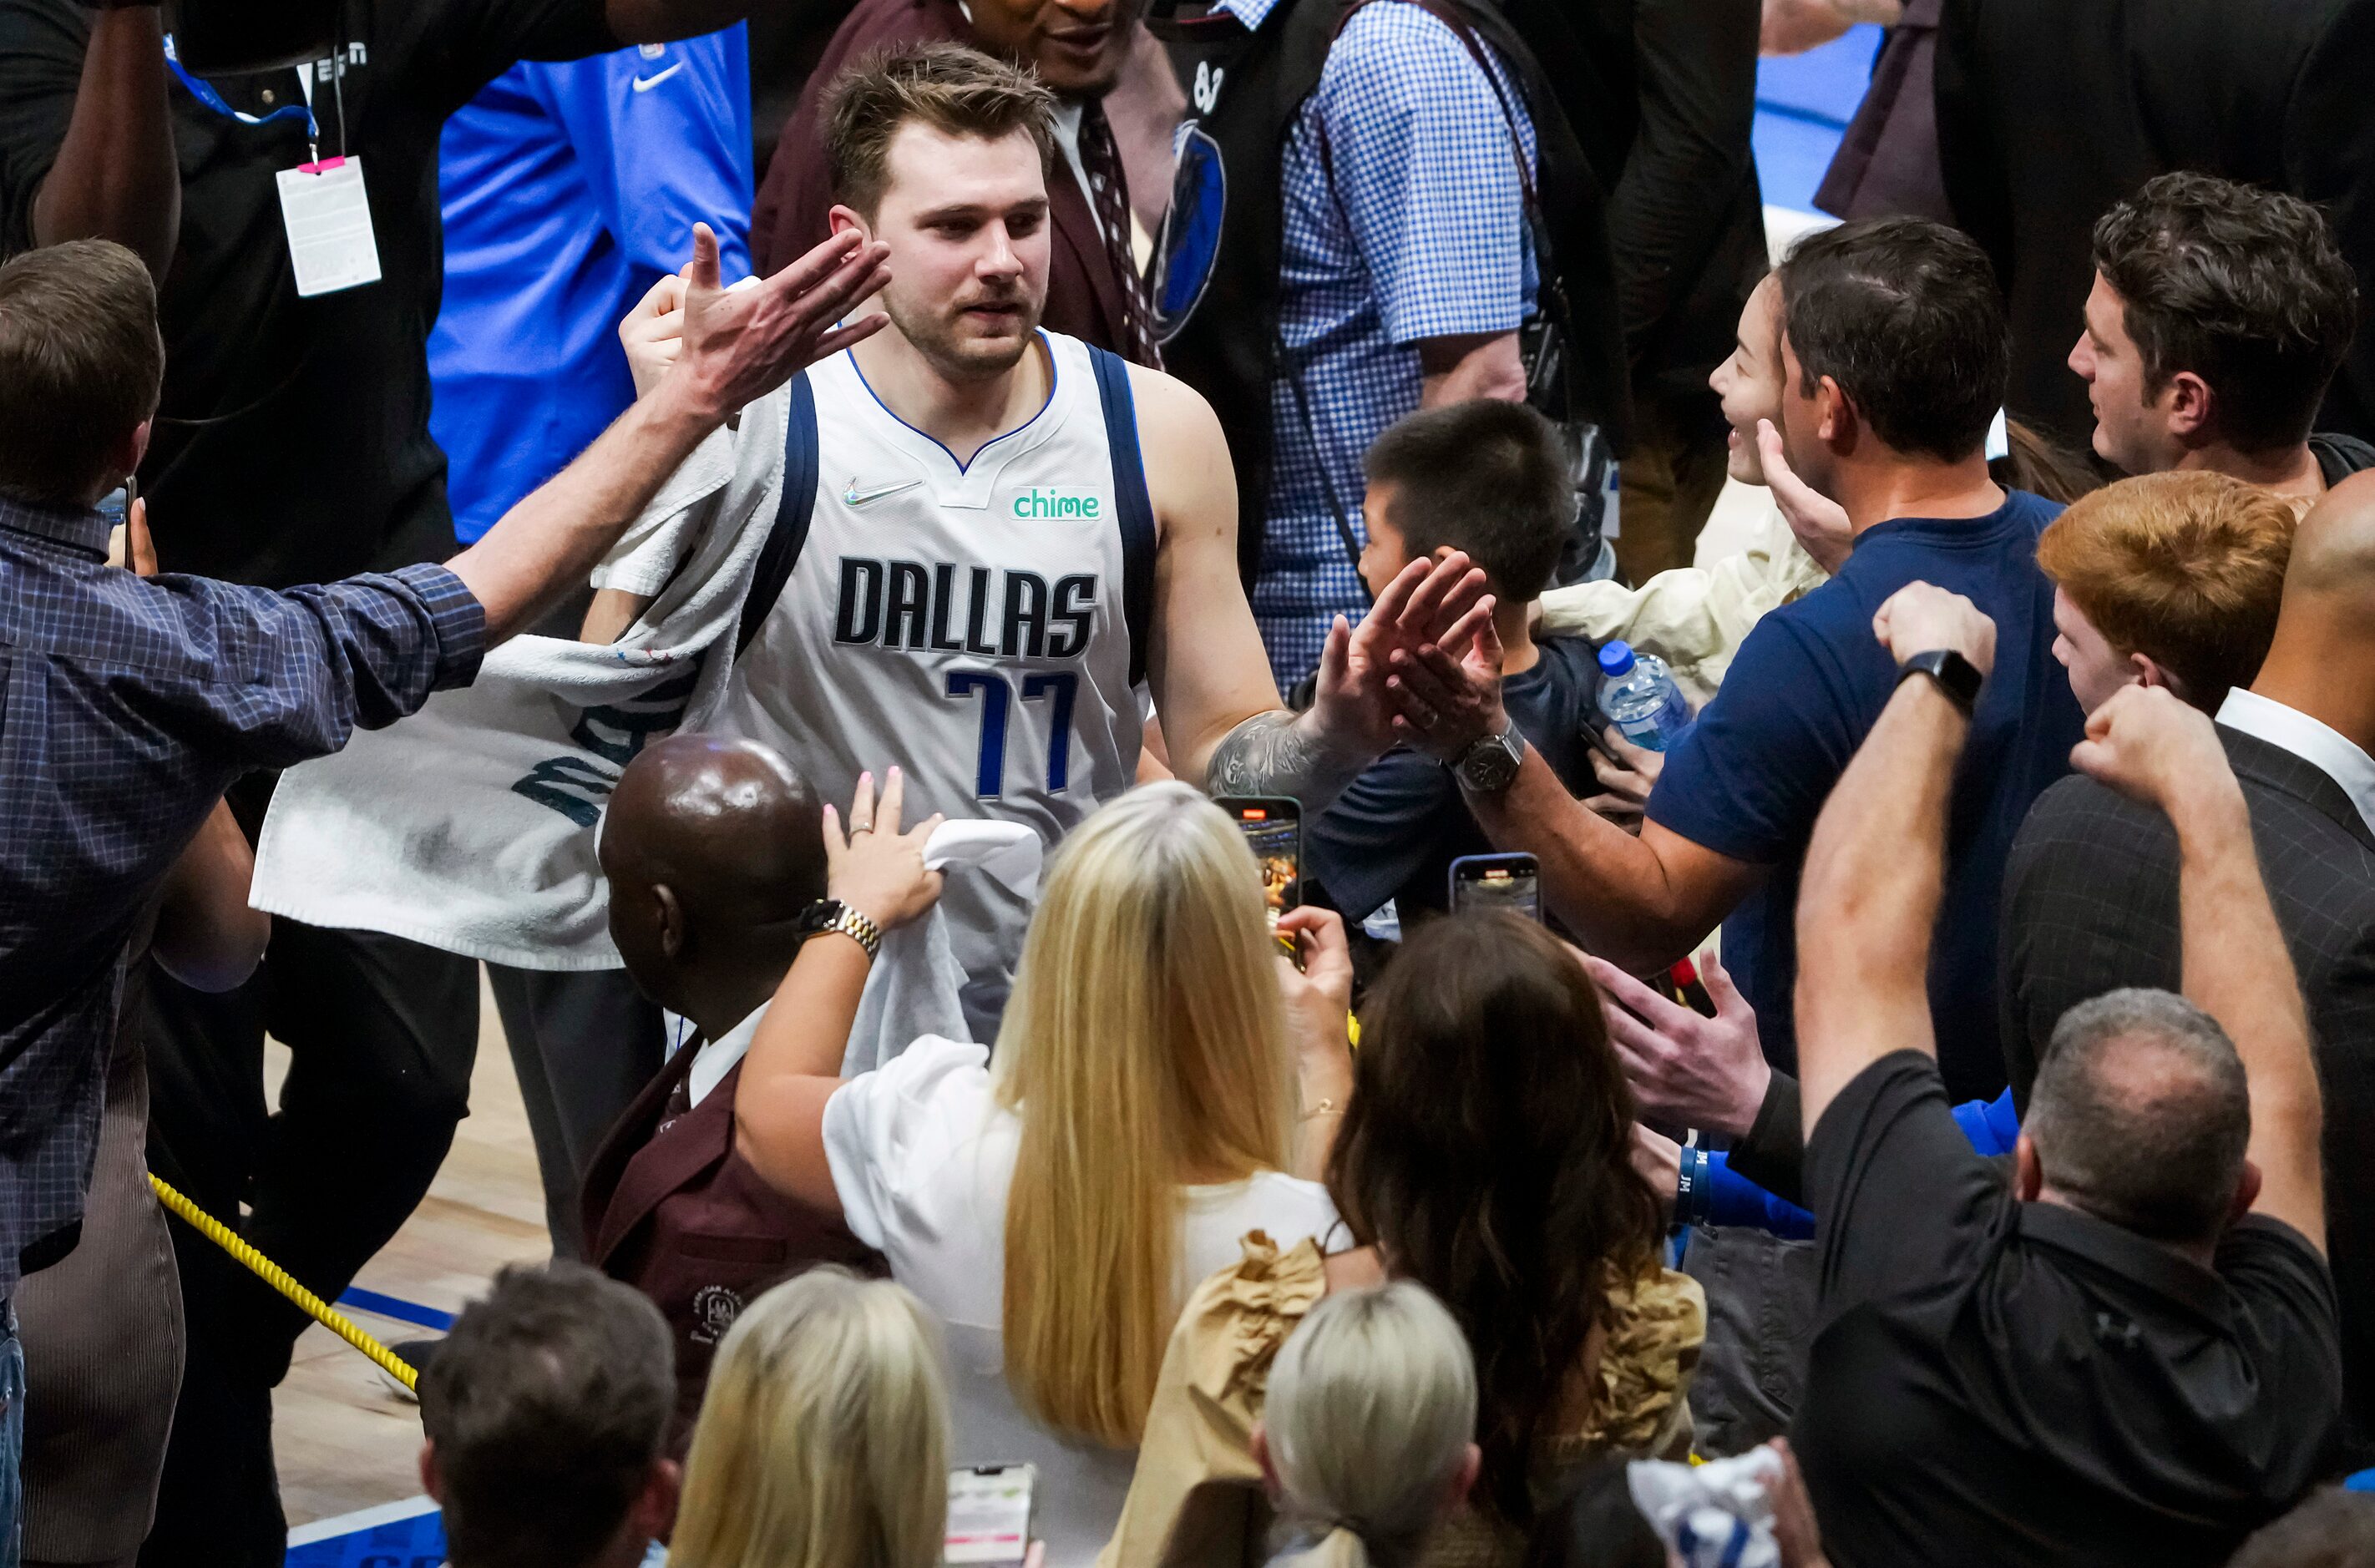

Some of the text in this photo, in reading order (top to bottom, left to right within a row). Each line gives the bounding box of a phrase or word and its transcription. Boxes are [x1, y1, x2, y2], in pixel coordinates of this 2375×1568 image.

[1014, 488, 1099, 518] chime
[833, 556, 1099, 661] DALLAS
[945, 669, 1080, 800] 77
[1679, 1174, 1692, 1192] JM
